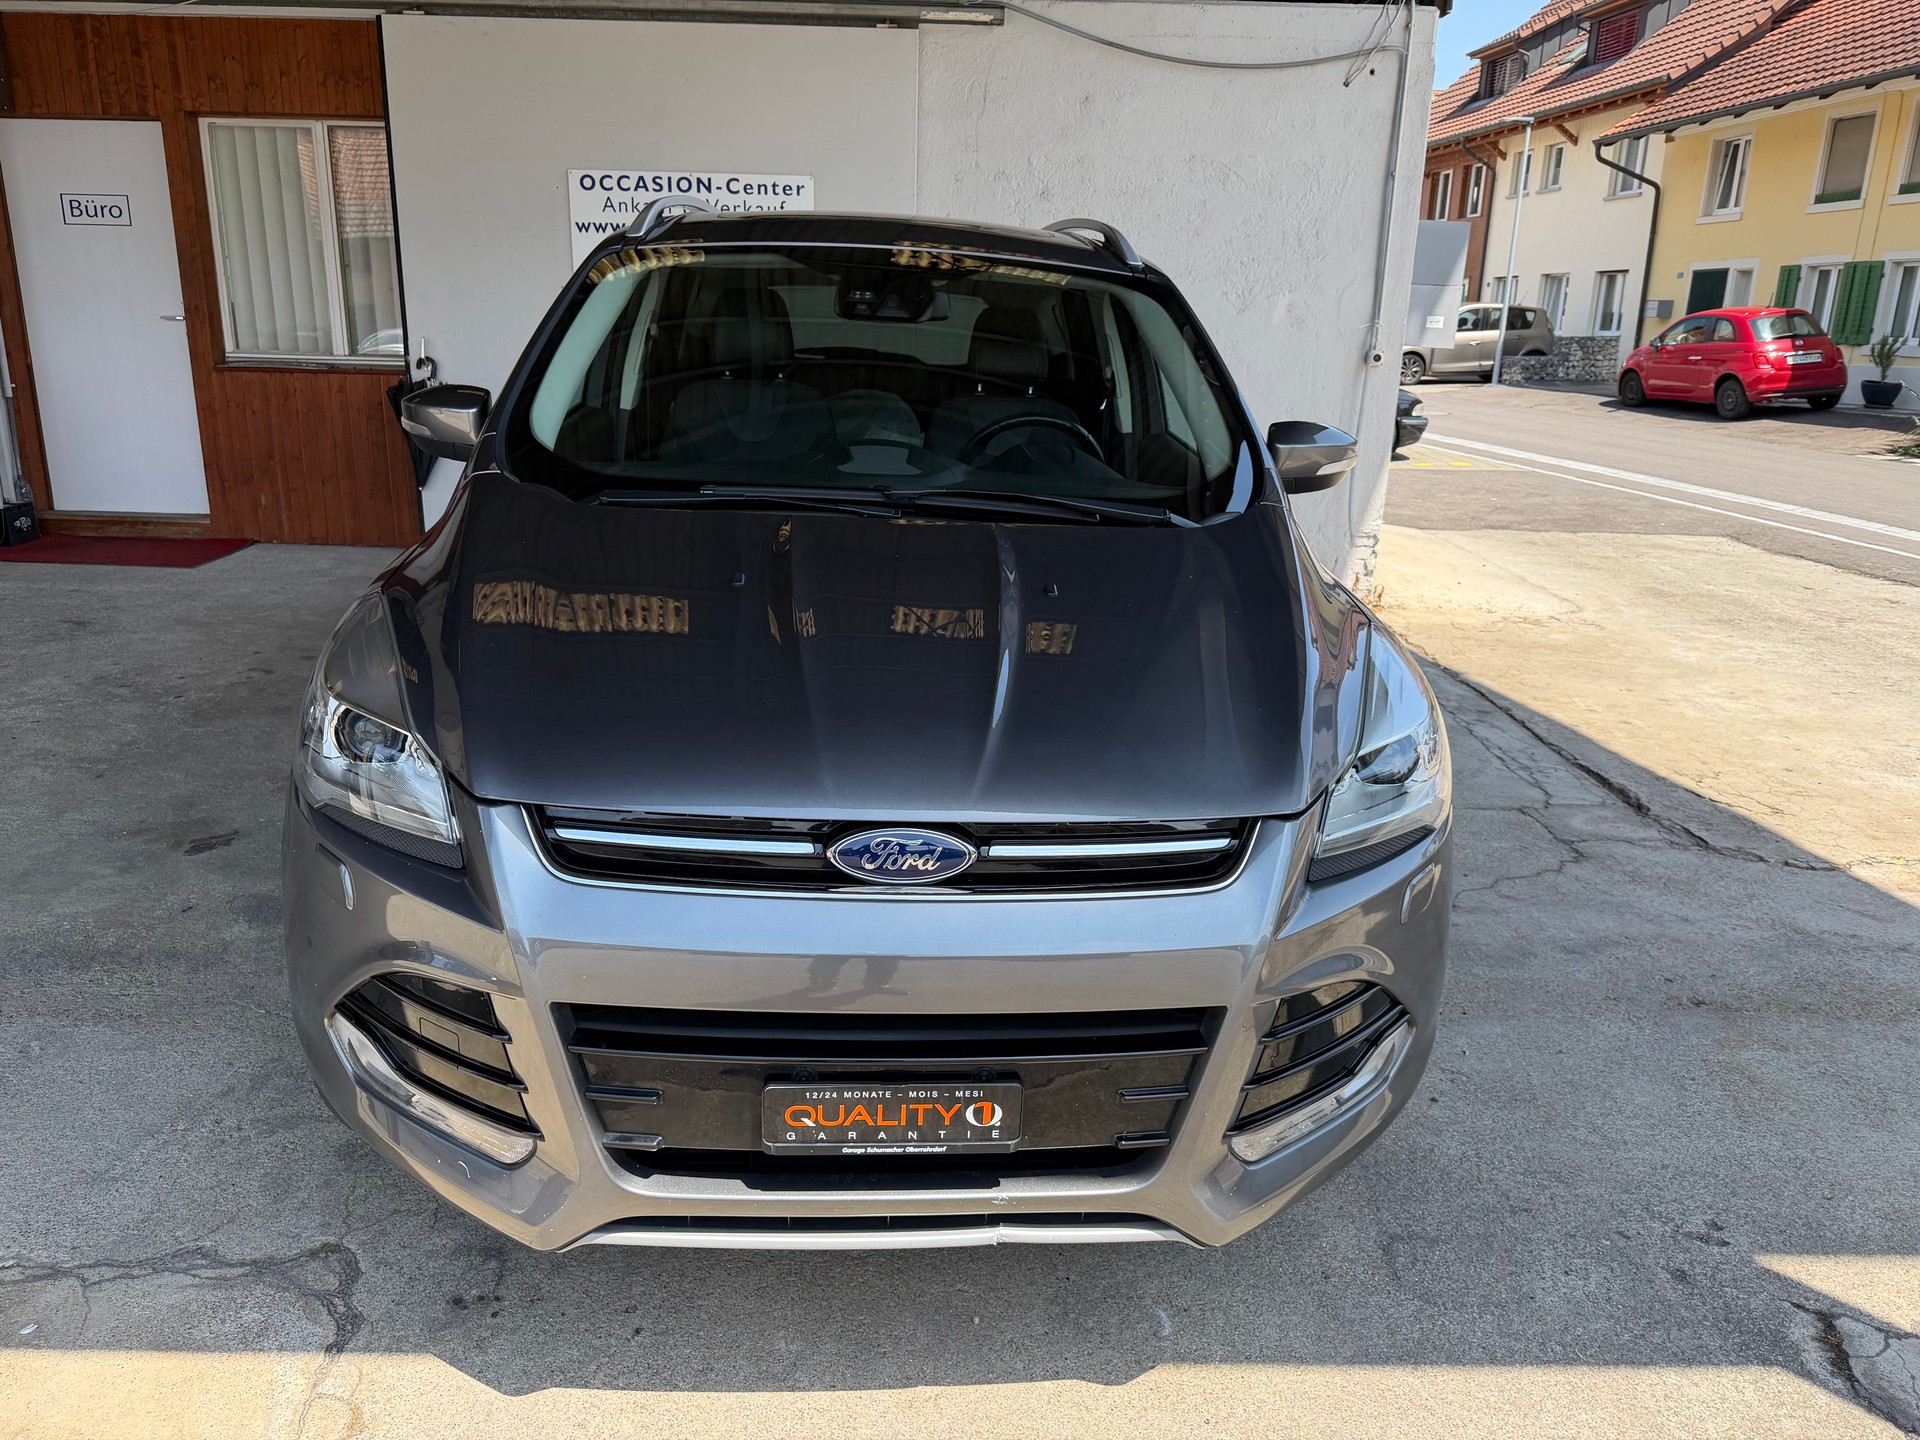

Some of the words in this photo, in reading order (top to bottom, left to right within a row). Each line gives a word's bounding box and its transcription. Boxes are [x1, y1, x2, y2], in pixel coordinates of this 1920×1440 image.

[579, 174, 805, 196] OCCASION-Center
[69, 199, 123, 218] Büro
[861, 837, 943, 871] Ford
[805, 1091, 838, 1099] 12/24
[843, 1090, 892, 1099] MONATE
[908, 1090, 939, 1098] MOIS
[955, 1090, 983, 1098] MESI
[784, 1104, 962, 1127] QUALITY
[905, 1145, 947, 1153] Oberrohrdorf
